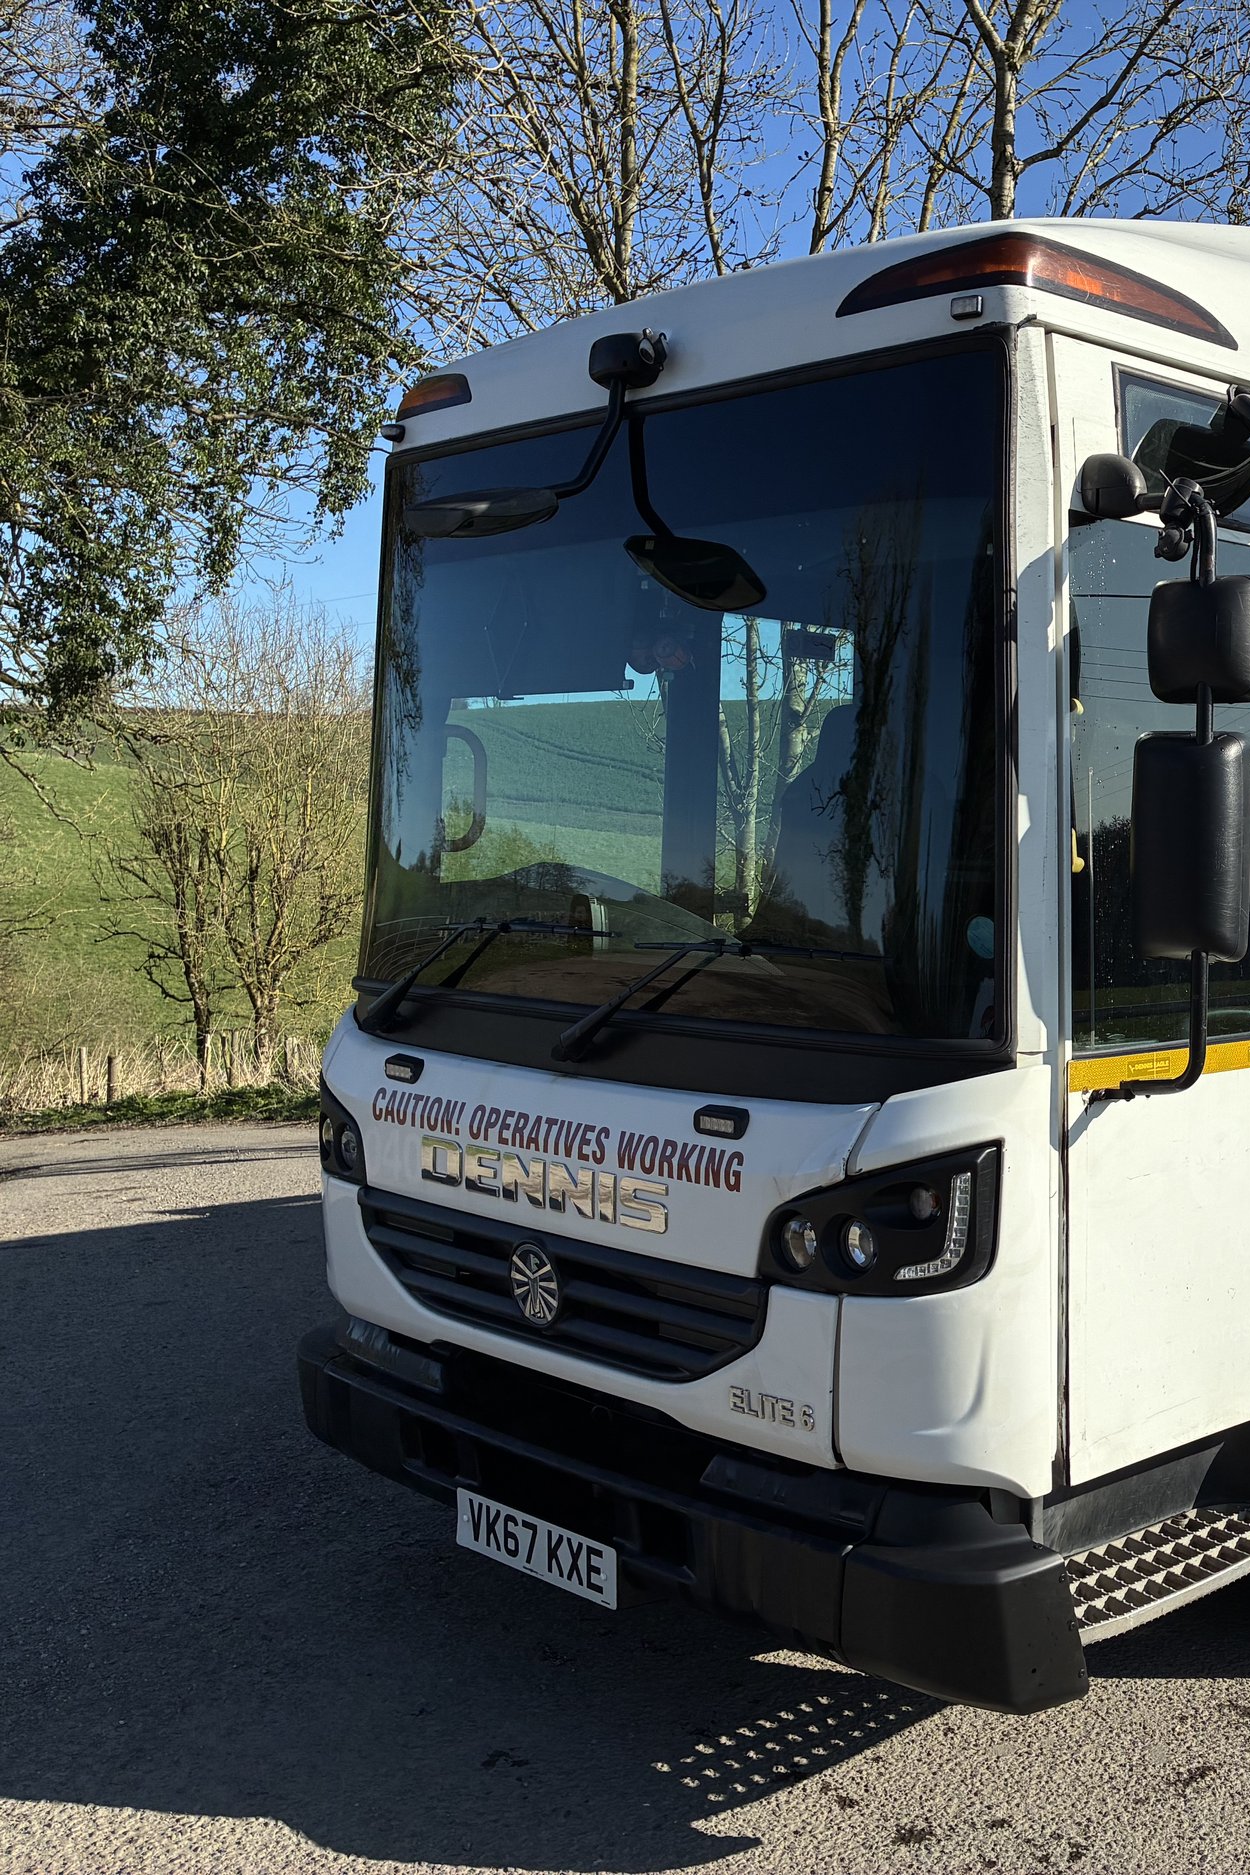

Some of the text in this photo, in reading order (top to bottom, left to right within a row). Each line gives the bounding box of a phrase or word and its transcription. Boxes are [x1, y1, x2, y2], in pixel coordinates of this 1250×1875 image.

[372, 1086, 745, 1193] CAUTION! OPERATIVES WORKING
[421, 1134, 669, 1235] DENNIS
[728, 1384, 815, 1432] ELITE 6
[468, 1497, 604, 1595] VK67 KXE
